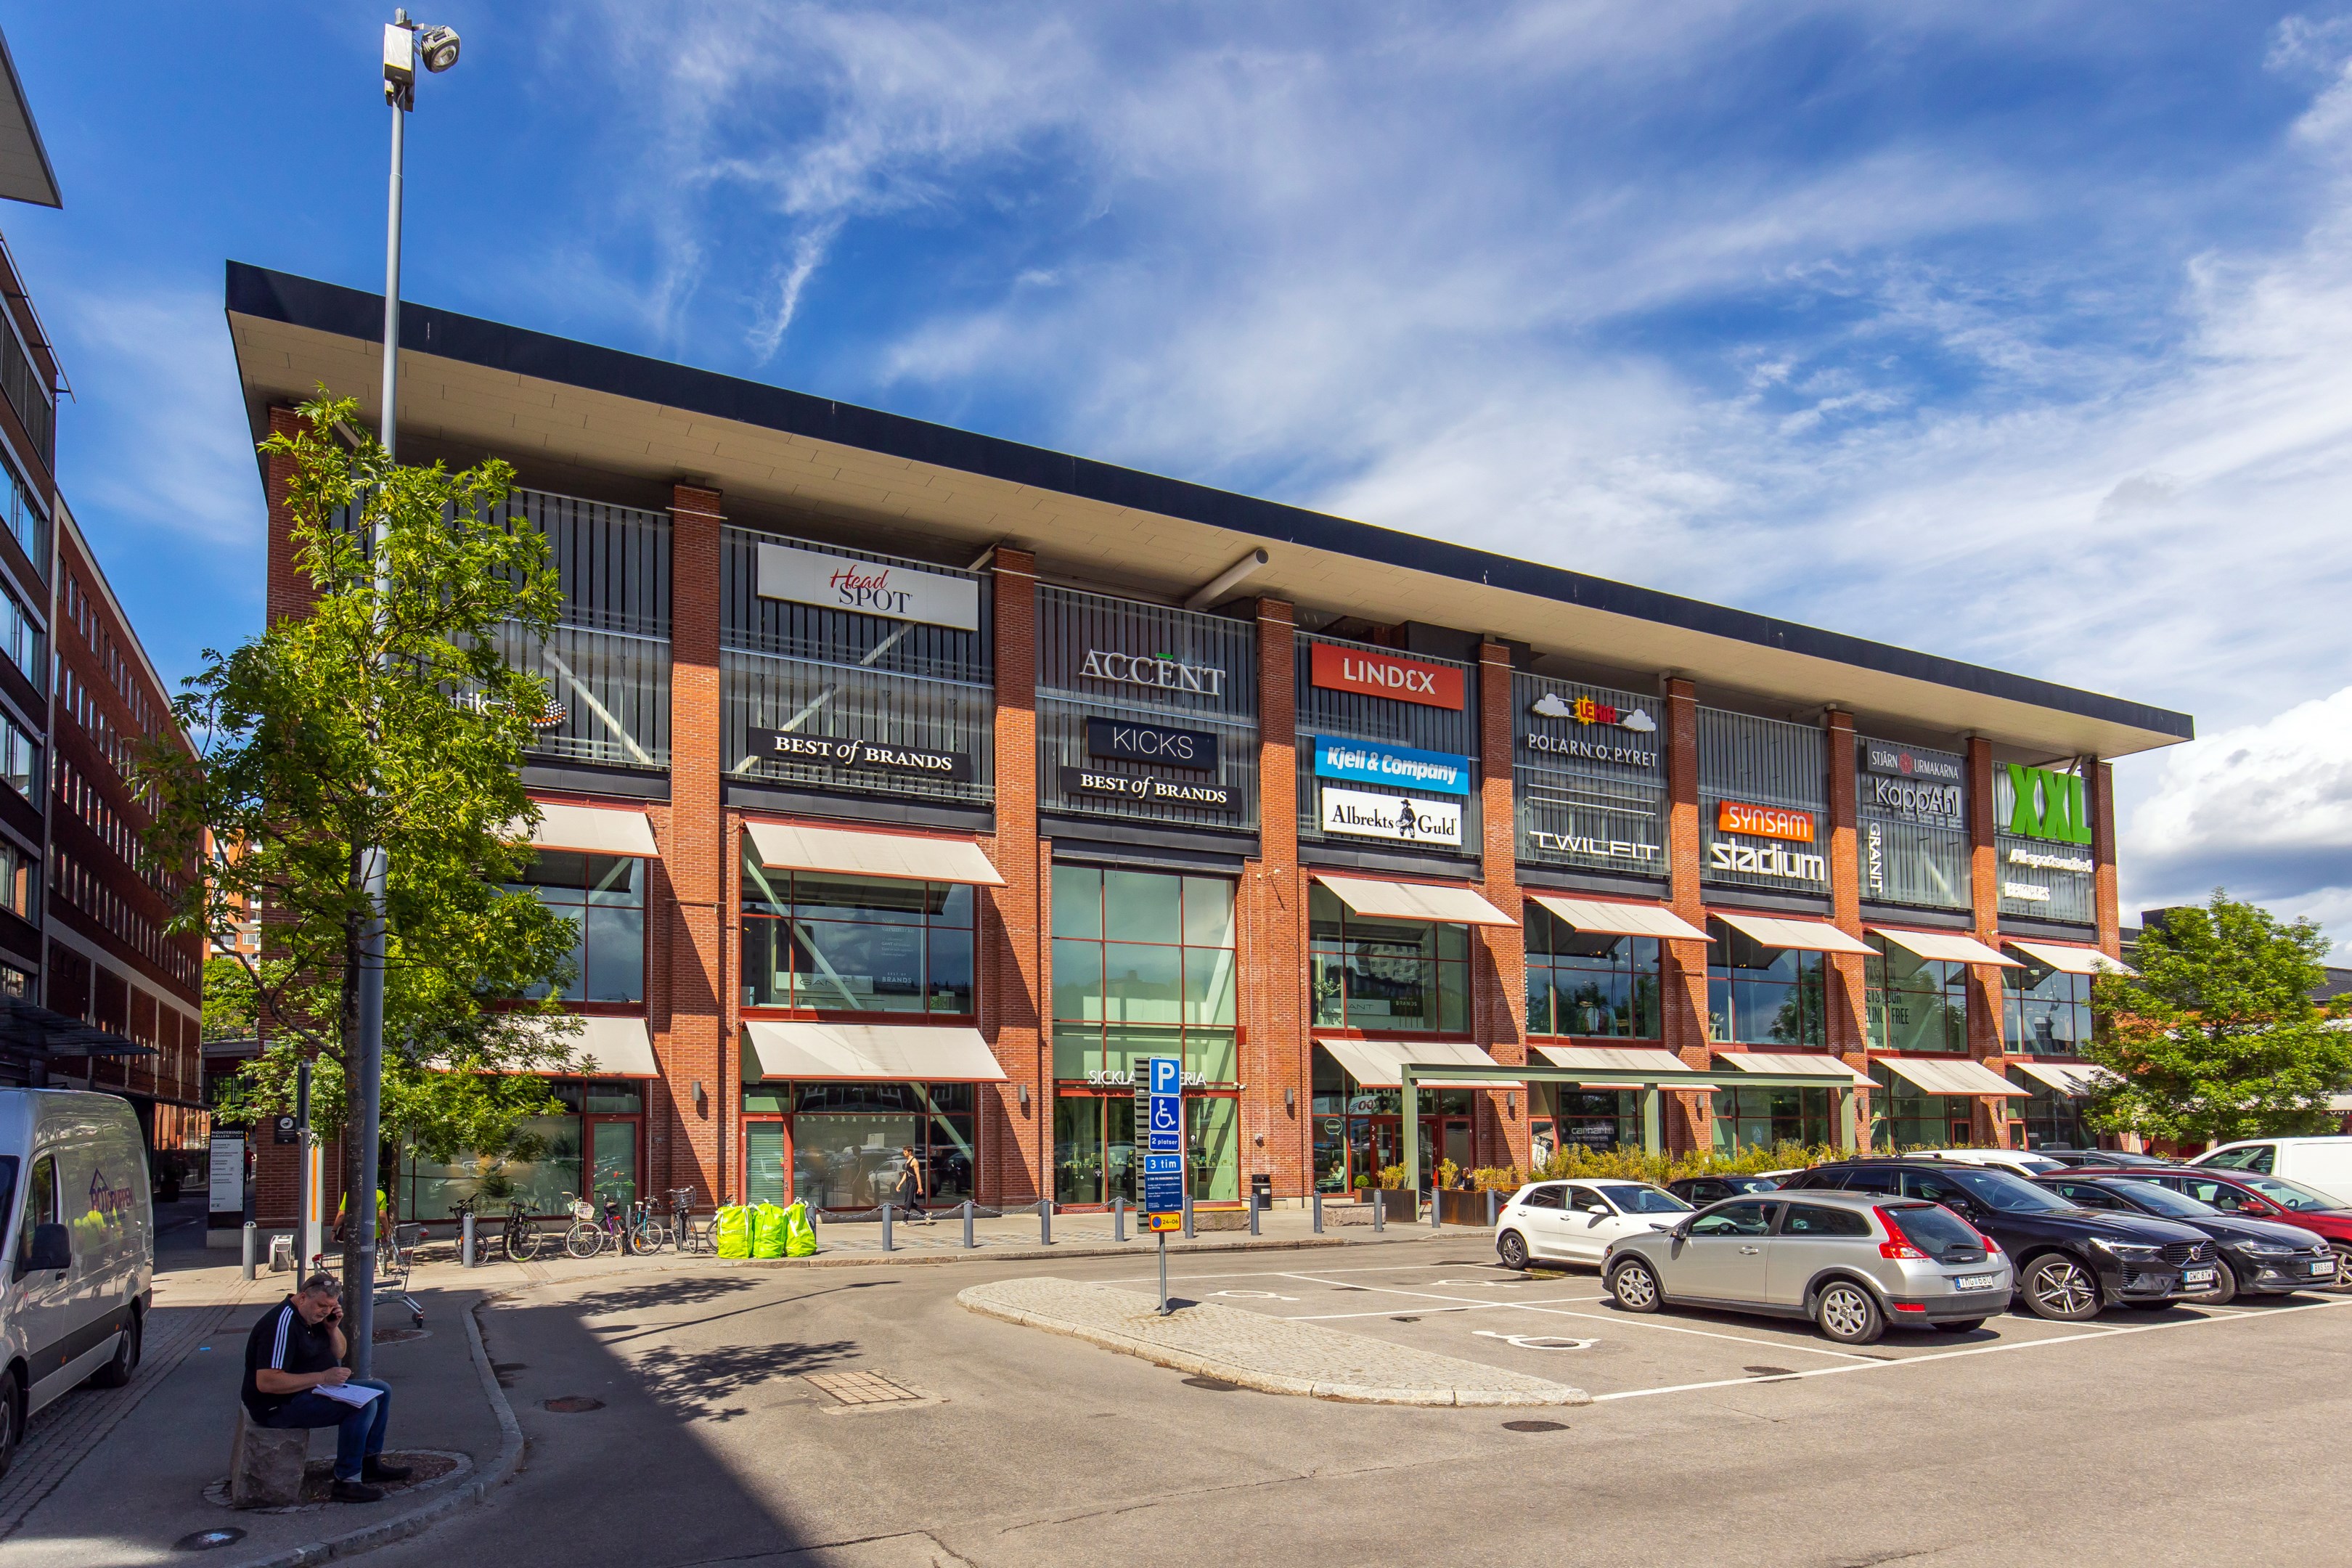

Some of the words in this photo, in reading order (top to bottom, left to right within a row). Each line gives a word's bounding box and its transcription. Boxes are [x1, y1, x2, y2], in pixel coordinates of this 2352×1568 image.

[830, 564, 889, 589] Head
[839, 582, 911, 614] SPOT
[1079, 649, 1225, 695] ACCENT
[1344, 658, 1436, 695] LINDEX
[775, 736, 833, 757] BEST
[836, 740, 864, 764] of
[865, 747, 952, 771] BRANDS
[1114, 727, 1193, 759] KICKS
[1528, 732, 1591, 757] POLARN
[1596, 744, 1611, 760] O.
[1614, 747, 1657, 767] PYRET
[1327, 746, 1365, 770] Kjell
[1367, 752, 1380, 772] &
[1381, 754, 1458, 785] Company
[1872, 751, 1898, 769] STJÄRN
[1914, 759, 1959, 780] URMAKARNA
[1080, 774, 1128, 792] BEST
[1131, 776, 1154, 799] of
[1154, 783, 1228, 804] BRANDS
[1875, 777, 1959, 817] KappAhl
[2007, 763, 2092, 845] XXL
[1330, 804, 1395, 829] Albrekts
[1418, 814, 1455, 836] Guld
[1529, 830, 1660, 860] TWILFIT
[1710, 838, 1825, 881] stadium
[1869, 822, 1883, 893] GRANIT
[1892, 1008, 1909, 1024] FREE
[1158, 1062, 1175, 1090] P
[1150, 1159, 1156, 1169] 3
[1161, 1159, 1177, 1168] tim
